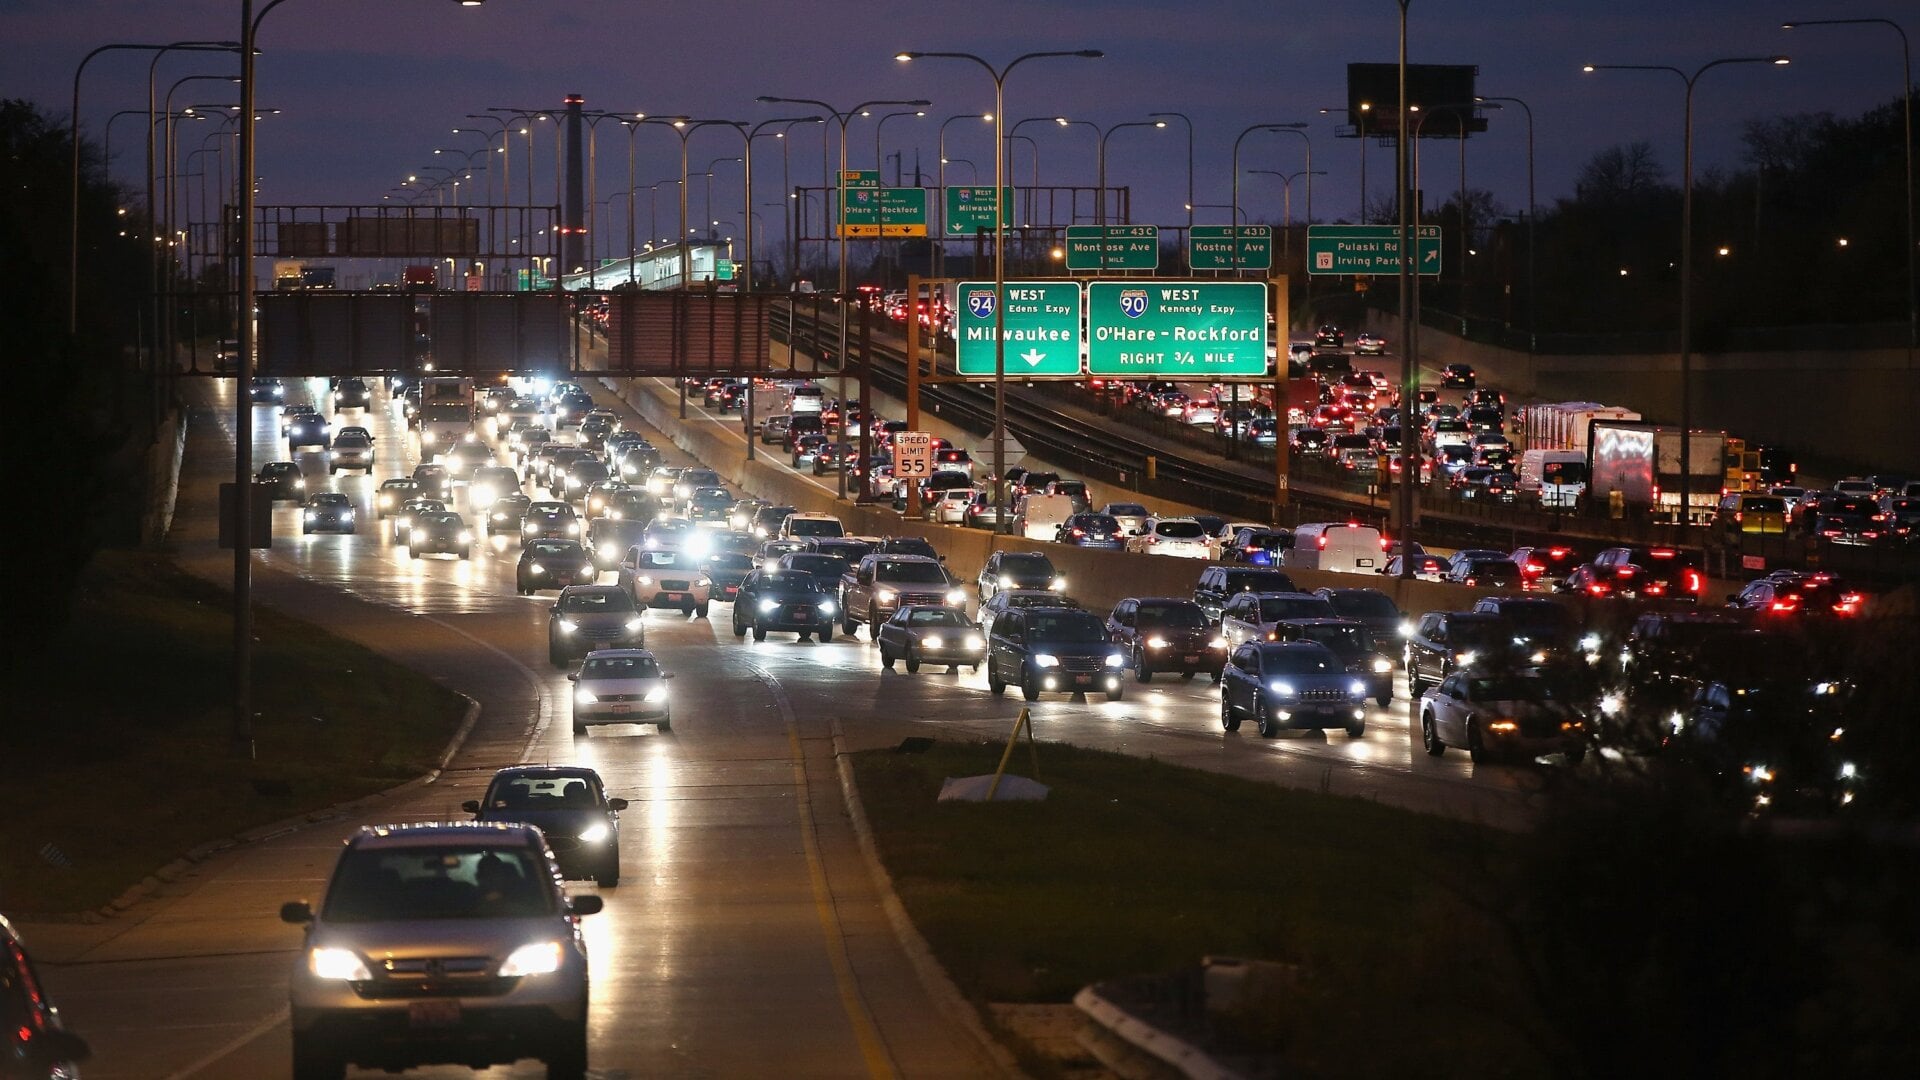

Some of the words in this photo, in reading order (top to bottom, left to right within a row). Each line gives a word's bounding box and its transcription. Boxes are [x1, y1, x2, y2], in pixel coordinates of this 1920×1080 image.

[1074, 243, 1124, 252] Montose
[1130, 243, 1150, 251] Ave
[1196, 243, 1232, 251] Kostne
[1244, 243, 1264, 251] Ave
[1338, 242, 1379, 250] Pulaski
[1384, 242, 1397, 250] Rd
[1338, 257, 1370, 267] Irving
[1009, 290, 1046, 300] WEST
[1161, 290, 1200, 300] WEST
[970, 298, 992, 312] 94
[1009, 304, 1038, 312] Edens
[1046, 304, 1070, 315] Expy
[1121, 298, 1144, 312] 90
[1160, 304, 1202, 315] Kennedy
[1210, 304, 1234, 315] Expy
[1096, 326, 1156, 340] O'Hare
[1174, 326, 1258, 340] Rockford
[1120, 354, 1164, 364] RIGHT
[1204, 353, 1234, 363] MILE
[902, 460, 924, 472] 55
